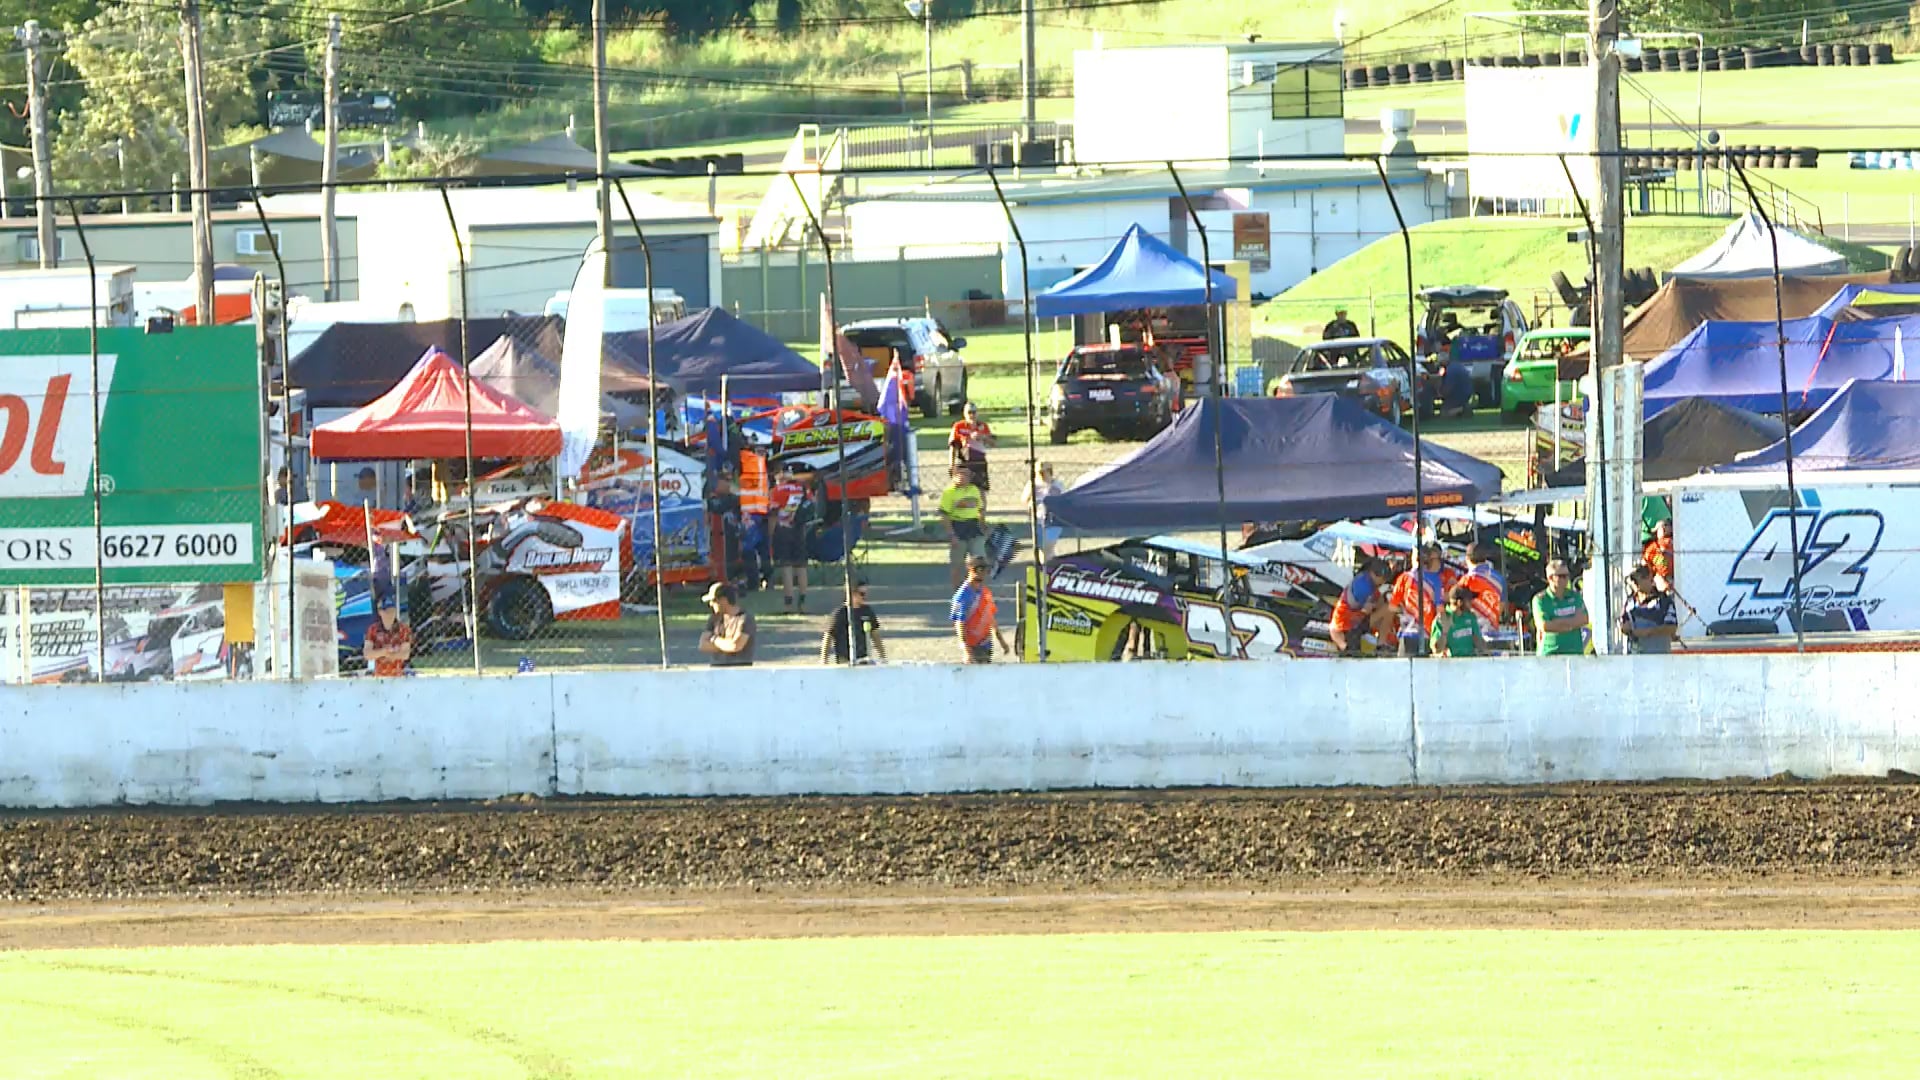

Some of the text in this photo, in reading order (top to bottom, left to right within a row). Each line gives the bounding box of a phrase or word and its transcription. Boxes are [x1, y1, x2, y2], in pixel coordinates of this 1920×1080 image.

[1386, 495, 1421, 507] RIDG
[0, 533, 238, 562] ORS 6627 6000
[1727, 507, 1886, 600] 42
[1050, 576, 1160, 605] PLUMBING
[1717, 585, 1887, 621] Young Racing
[1184, 600, 1297, 659] 42
[17, 643, 83, 657] CTION
